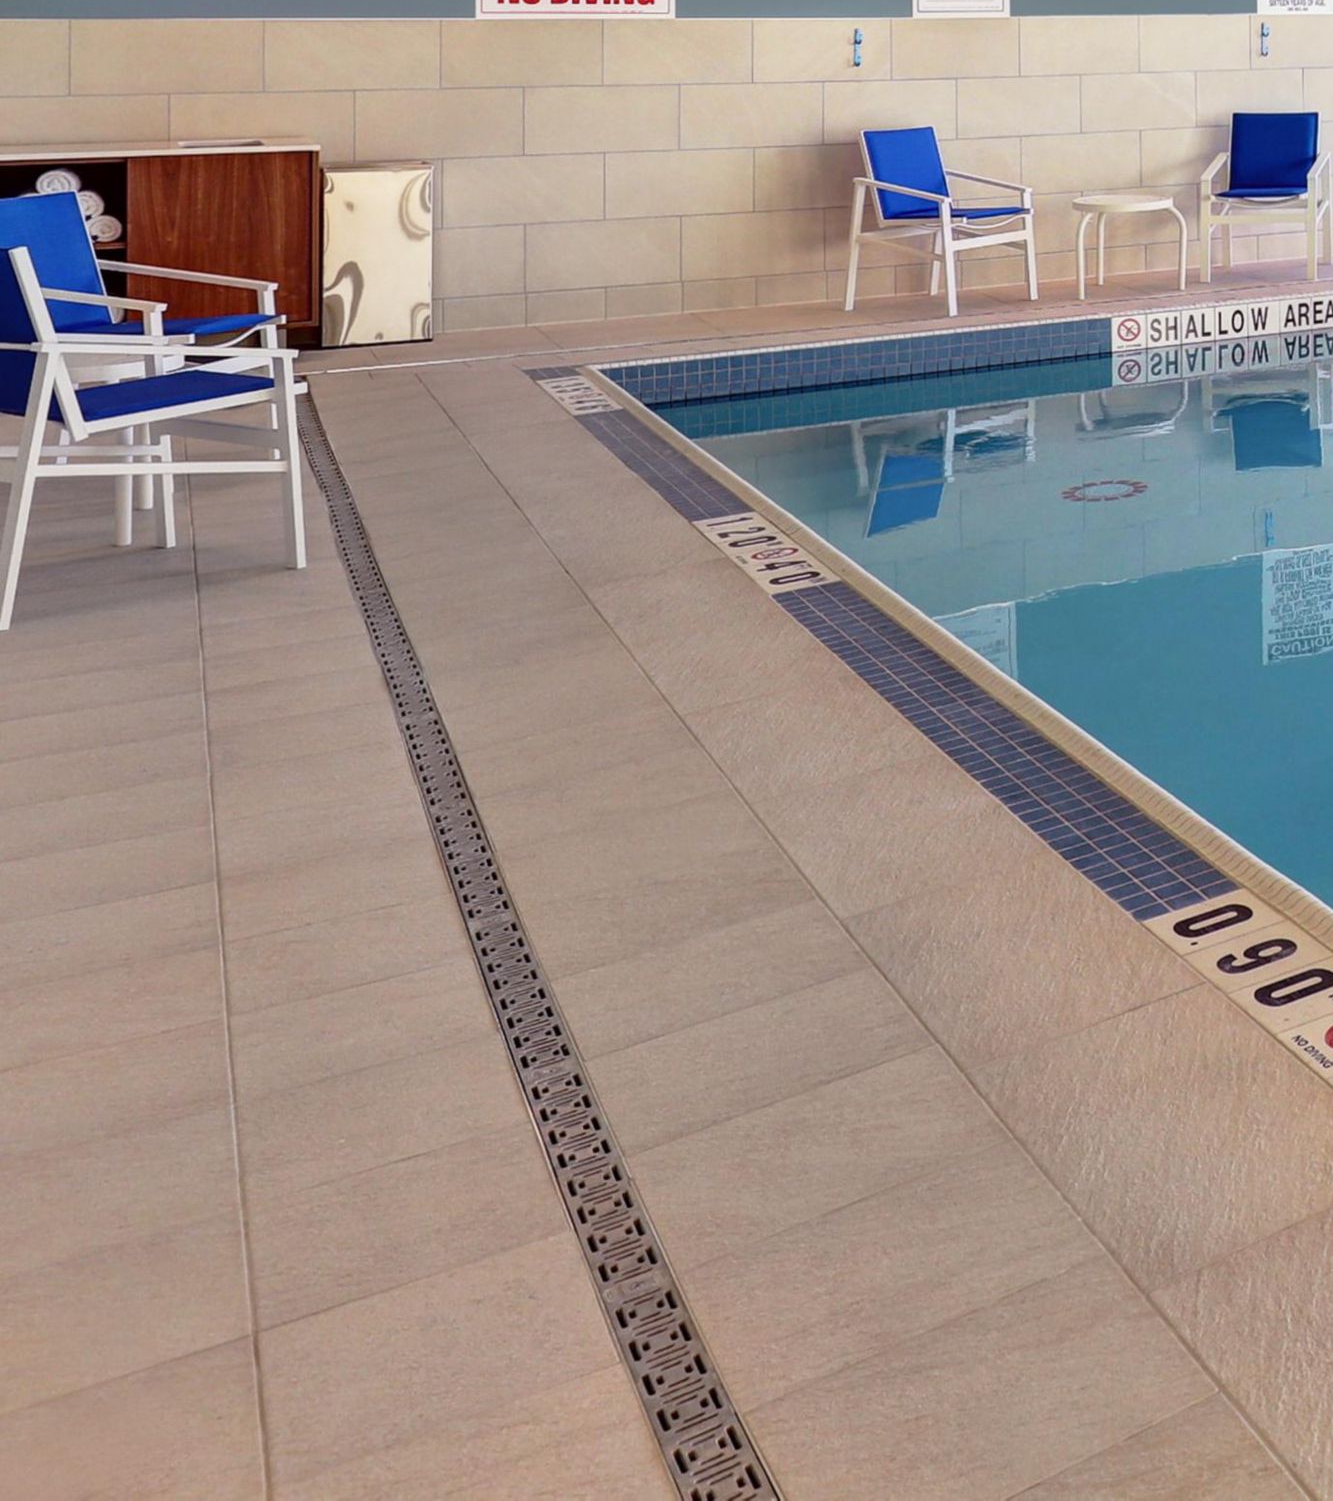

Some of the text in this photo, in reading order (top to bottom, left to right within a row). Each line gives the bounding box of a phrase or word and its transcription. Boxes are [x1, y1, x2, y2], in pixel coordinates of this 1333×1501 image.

[1150, 306, 1269, 342] SHALLOW
[1291, 1035, 1333, 1069] NO DIVING
